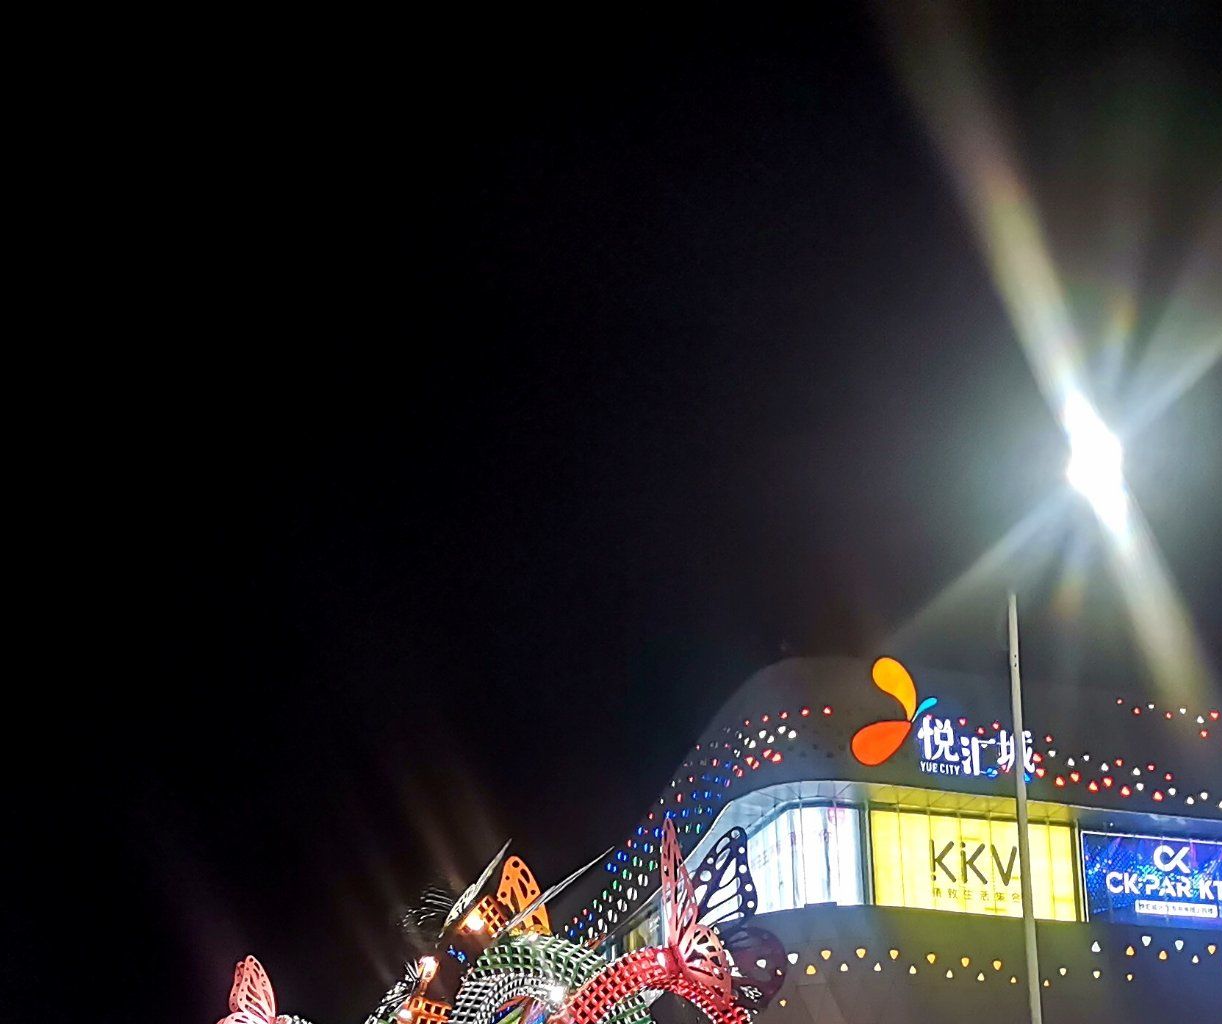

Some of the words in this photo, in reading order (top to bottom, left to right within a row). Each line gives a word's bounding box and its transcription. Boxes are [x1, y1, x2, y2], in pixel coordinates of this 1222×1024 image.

[917, 716, 1036, 777] 悦汇城
[920, 760, 938, 774] YUE
[940, 763, 961, 775] CITY
[929, 840, 1018, 886] KKV
